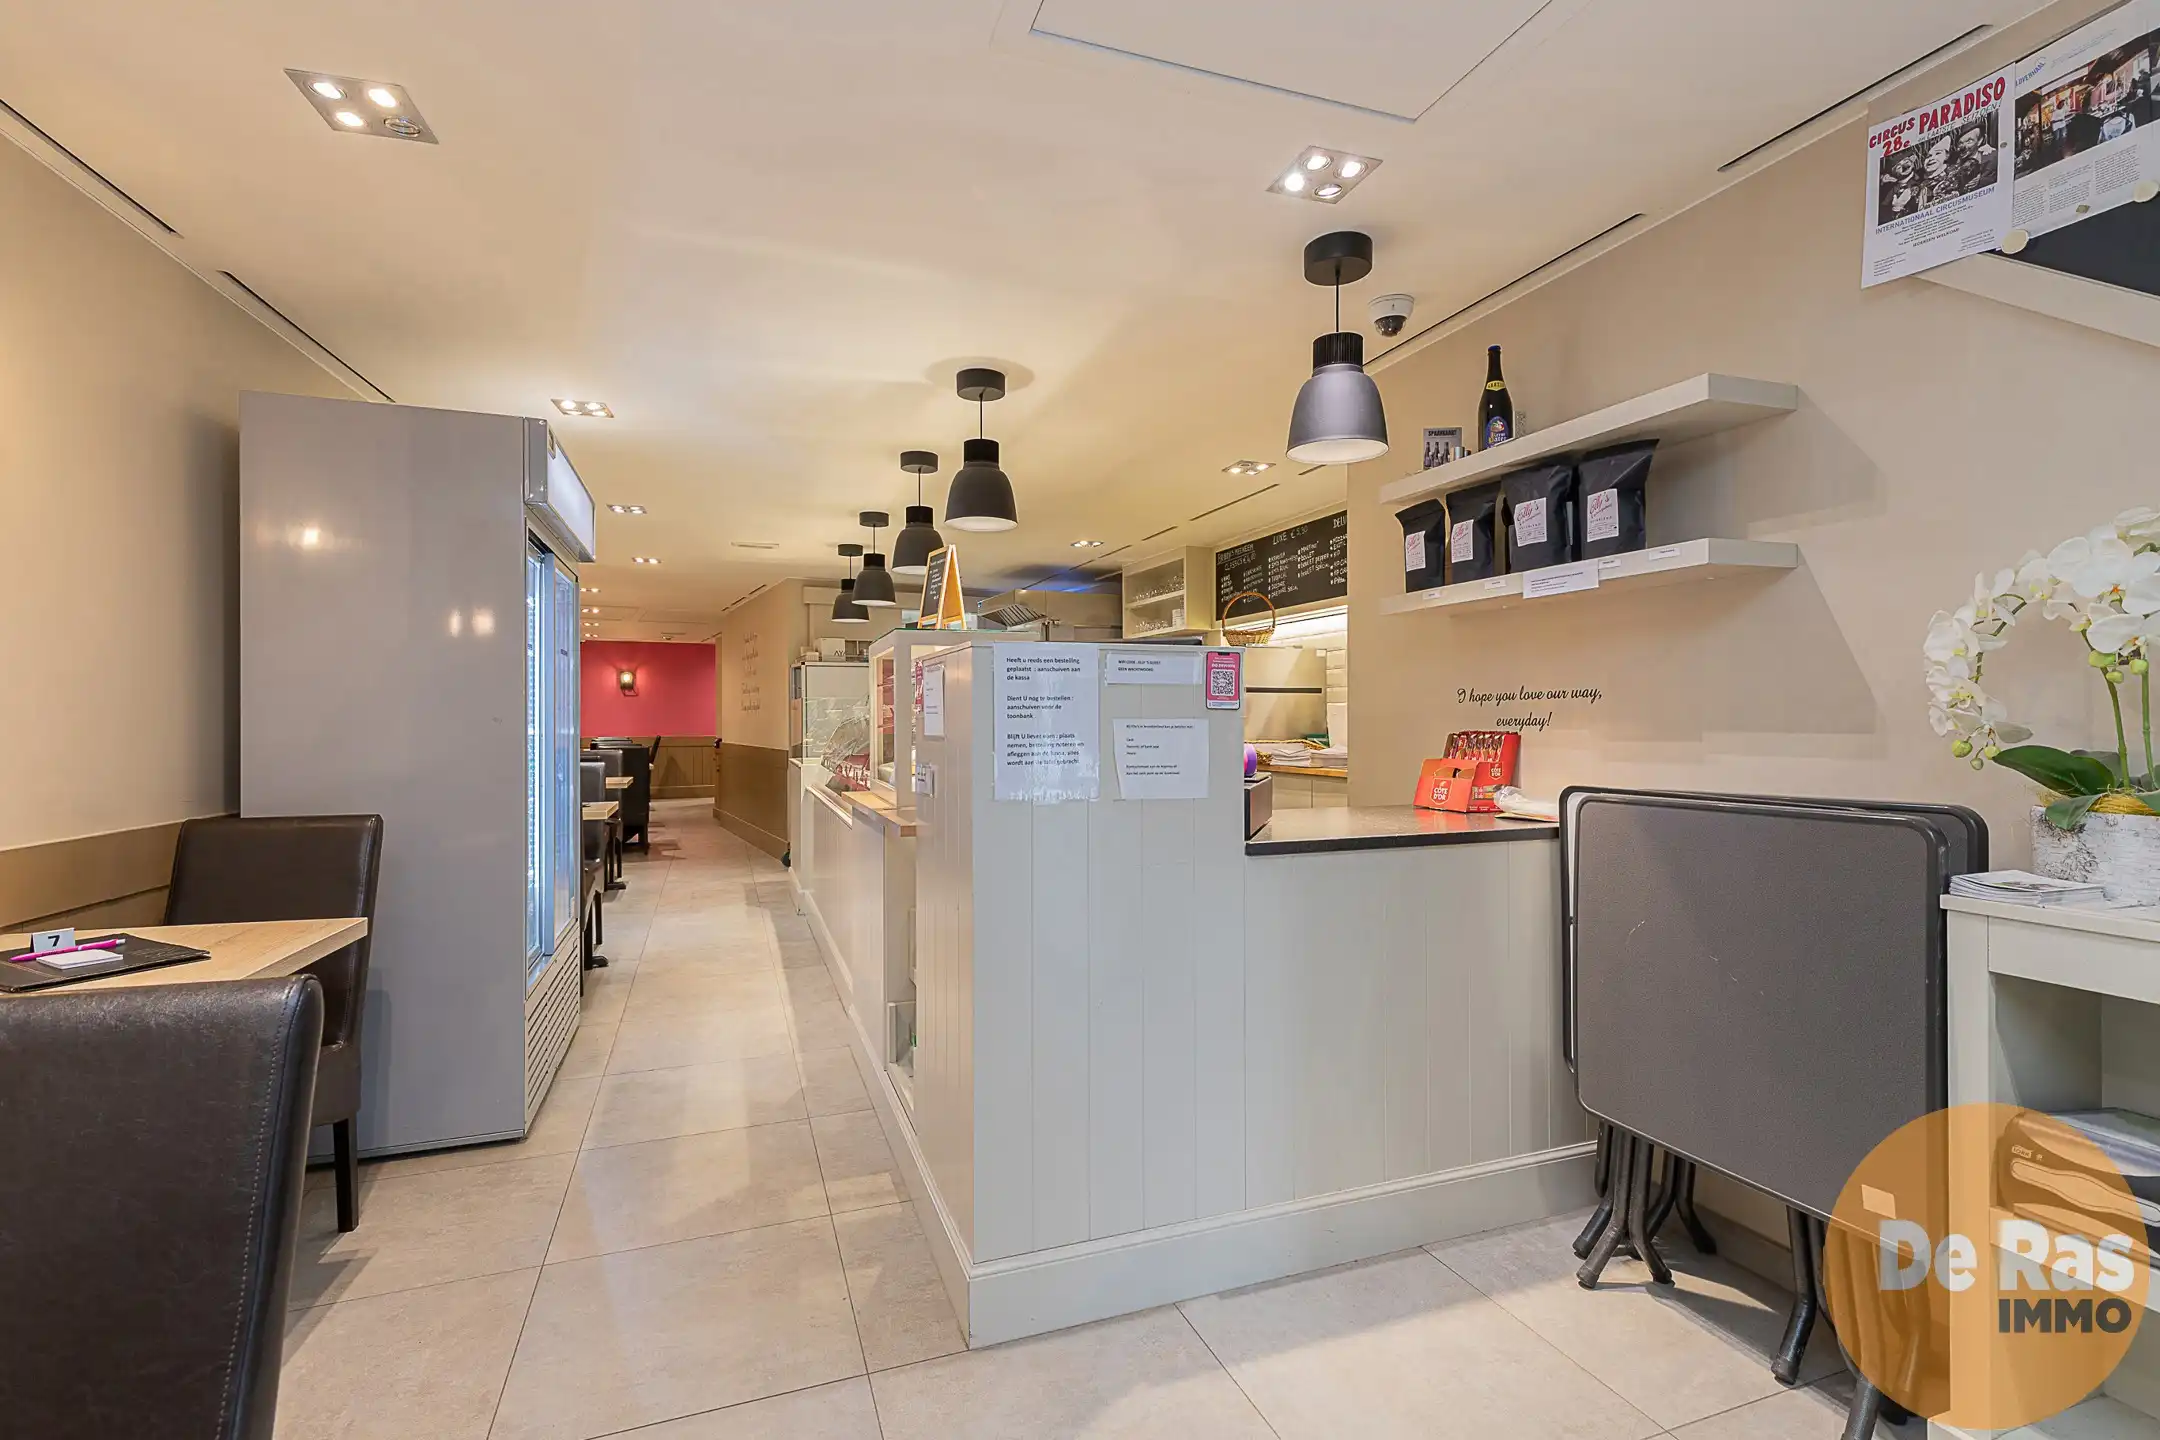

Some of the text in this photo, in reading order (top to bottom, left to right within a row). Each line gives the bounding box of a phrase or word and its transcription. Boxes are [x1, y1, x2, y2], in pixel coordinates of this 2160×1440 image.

[1869, 76, 2005, 148] CIRCUS PARADISO
[1875, 209, 1934, 235] INTERNATIONAAL
[1936, 186, 1995, 214] CIRCUSMUSEUM
[1333, 516, 1346, 528] DELU
[1457, 685, 1602, 707] I hope you love our way,
[1496, 711, 1553, 732] everyday!
[48, 935, 61, 947] 7
